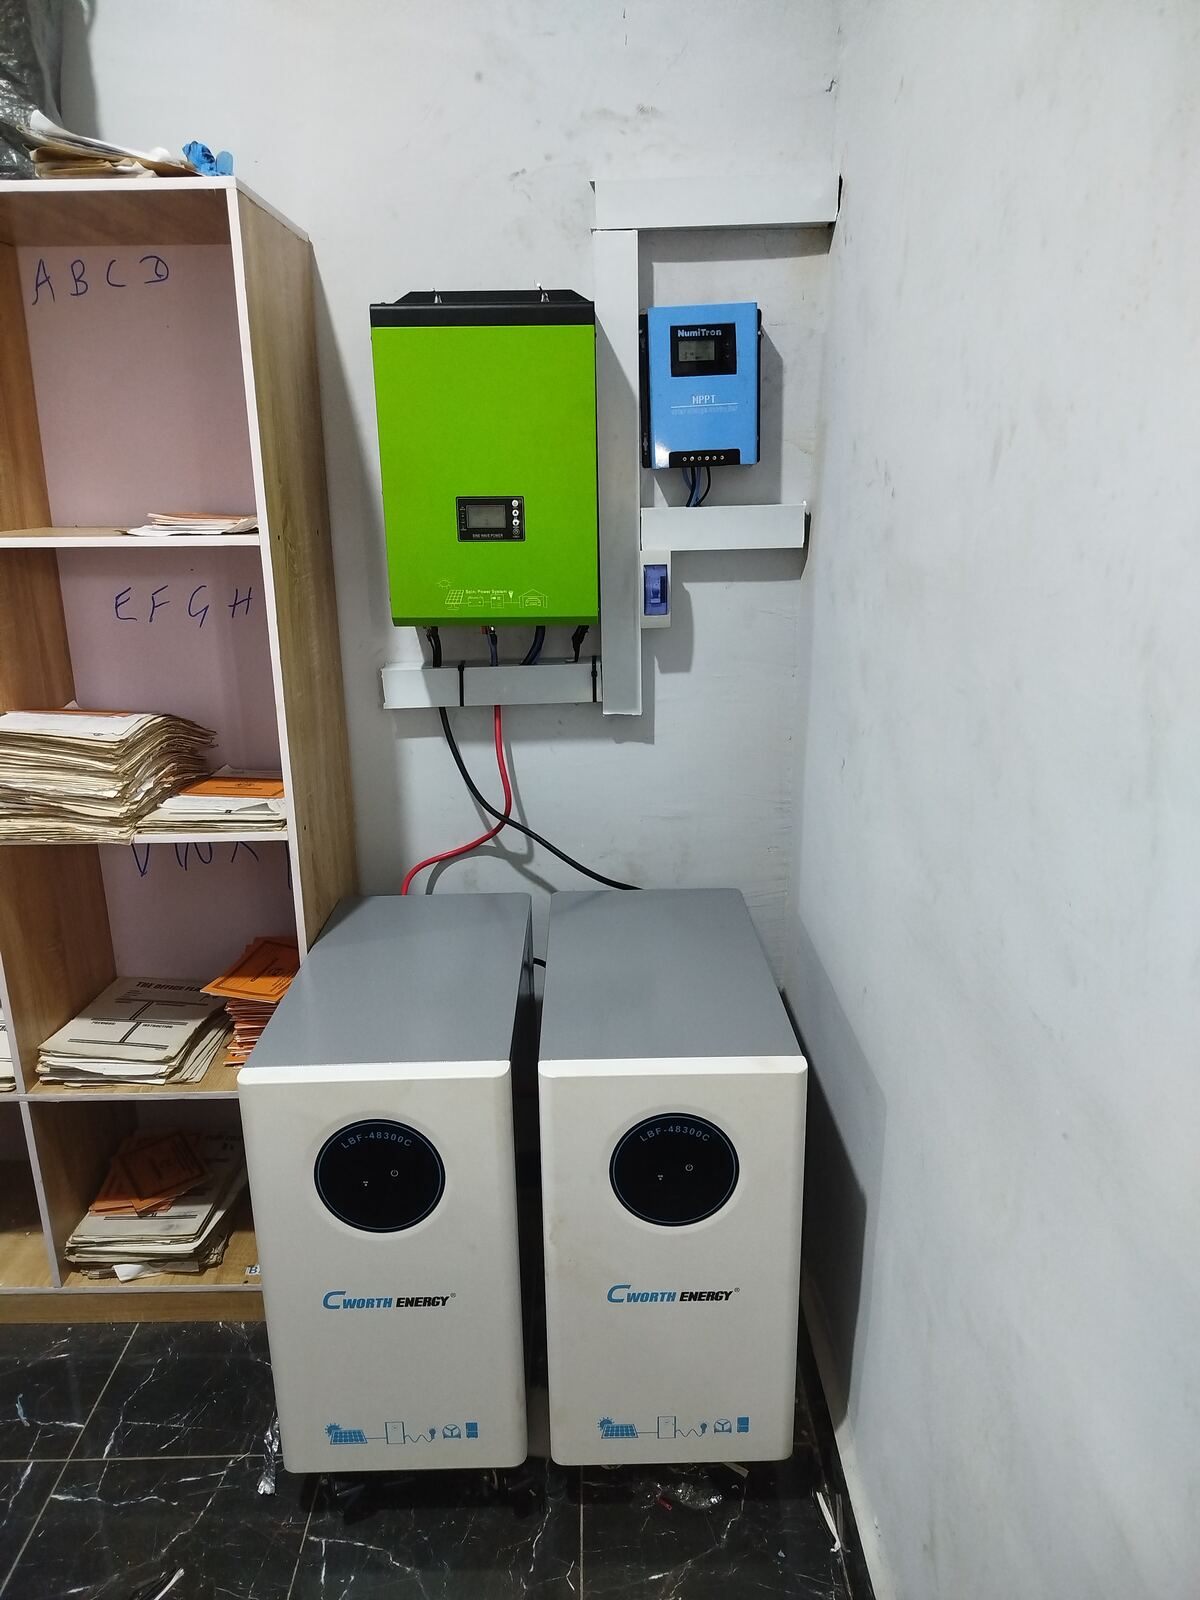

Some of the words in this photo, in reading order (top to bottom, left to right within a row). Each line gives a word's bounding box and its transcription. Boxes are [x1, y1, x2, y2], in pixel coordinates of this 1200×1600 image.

[31, 258, 56, 306] A
[70, 259, 89, 297] B
[106, 259, 127, 288] C
[139, 255, 170, 285] D
[677, 328, 722, 338] NumiTron
[114, 586, 138, 622] E
[149, 584, 171, 623] F
[188, 585, 210, 629] G
[228, 586, 253, 619] H
[341, 1131, 413, 1149] LBF-48300C
[639, 1125, 711, 1142] LBF-48300C
[322, 1290, 394, 1310] CWORTH
[395, 1296, 450, 1308] ENERGY
[606, 1284, 677, 1303] CWORTH
[679, 1290, 734, 1302] ENERGY
